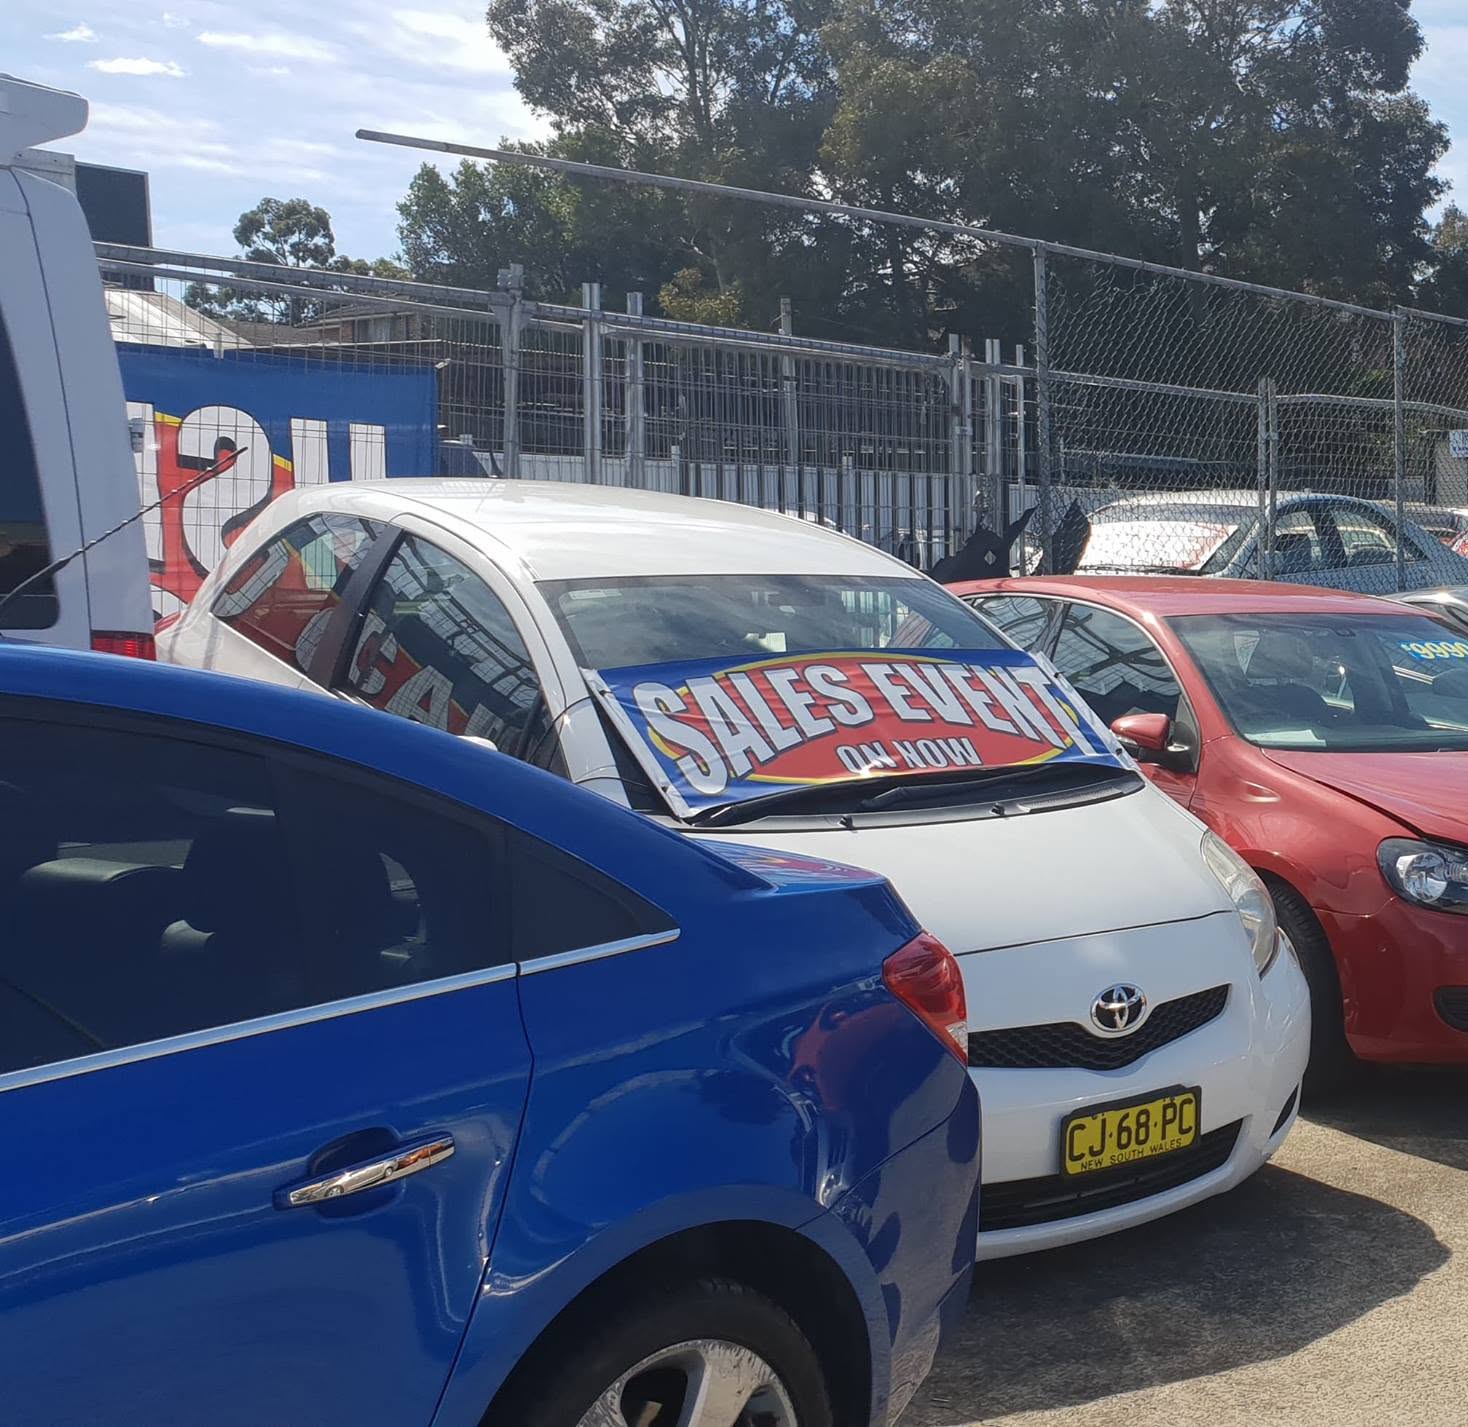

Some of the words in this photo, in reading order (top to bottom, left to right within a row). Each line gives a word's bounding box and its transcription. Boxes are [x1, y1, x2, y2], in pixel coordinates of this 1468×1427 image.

[632, 662, 875, 795] SALES
[859, 662, 1093, 756] EVENT
[836, 740, 898, 775] ON
[892, 736, 984, 769] NOW
[1080, 1159, 1104, 1171] NEW
[1110, 1149, 1144, 1165] SOUTH
[1149, 1137, 1182, 1153] WALES
